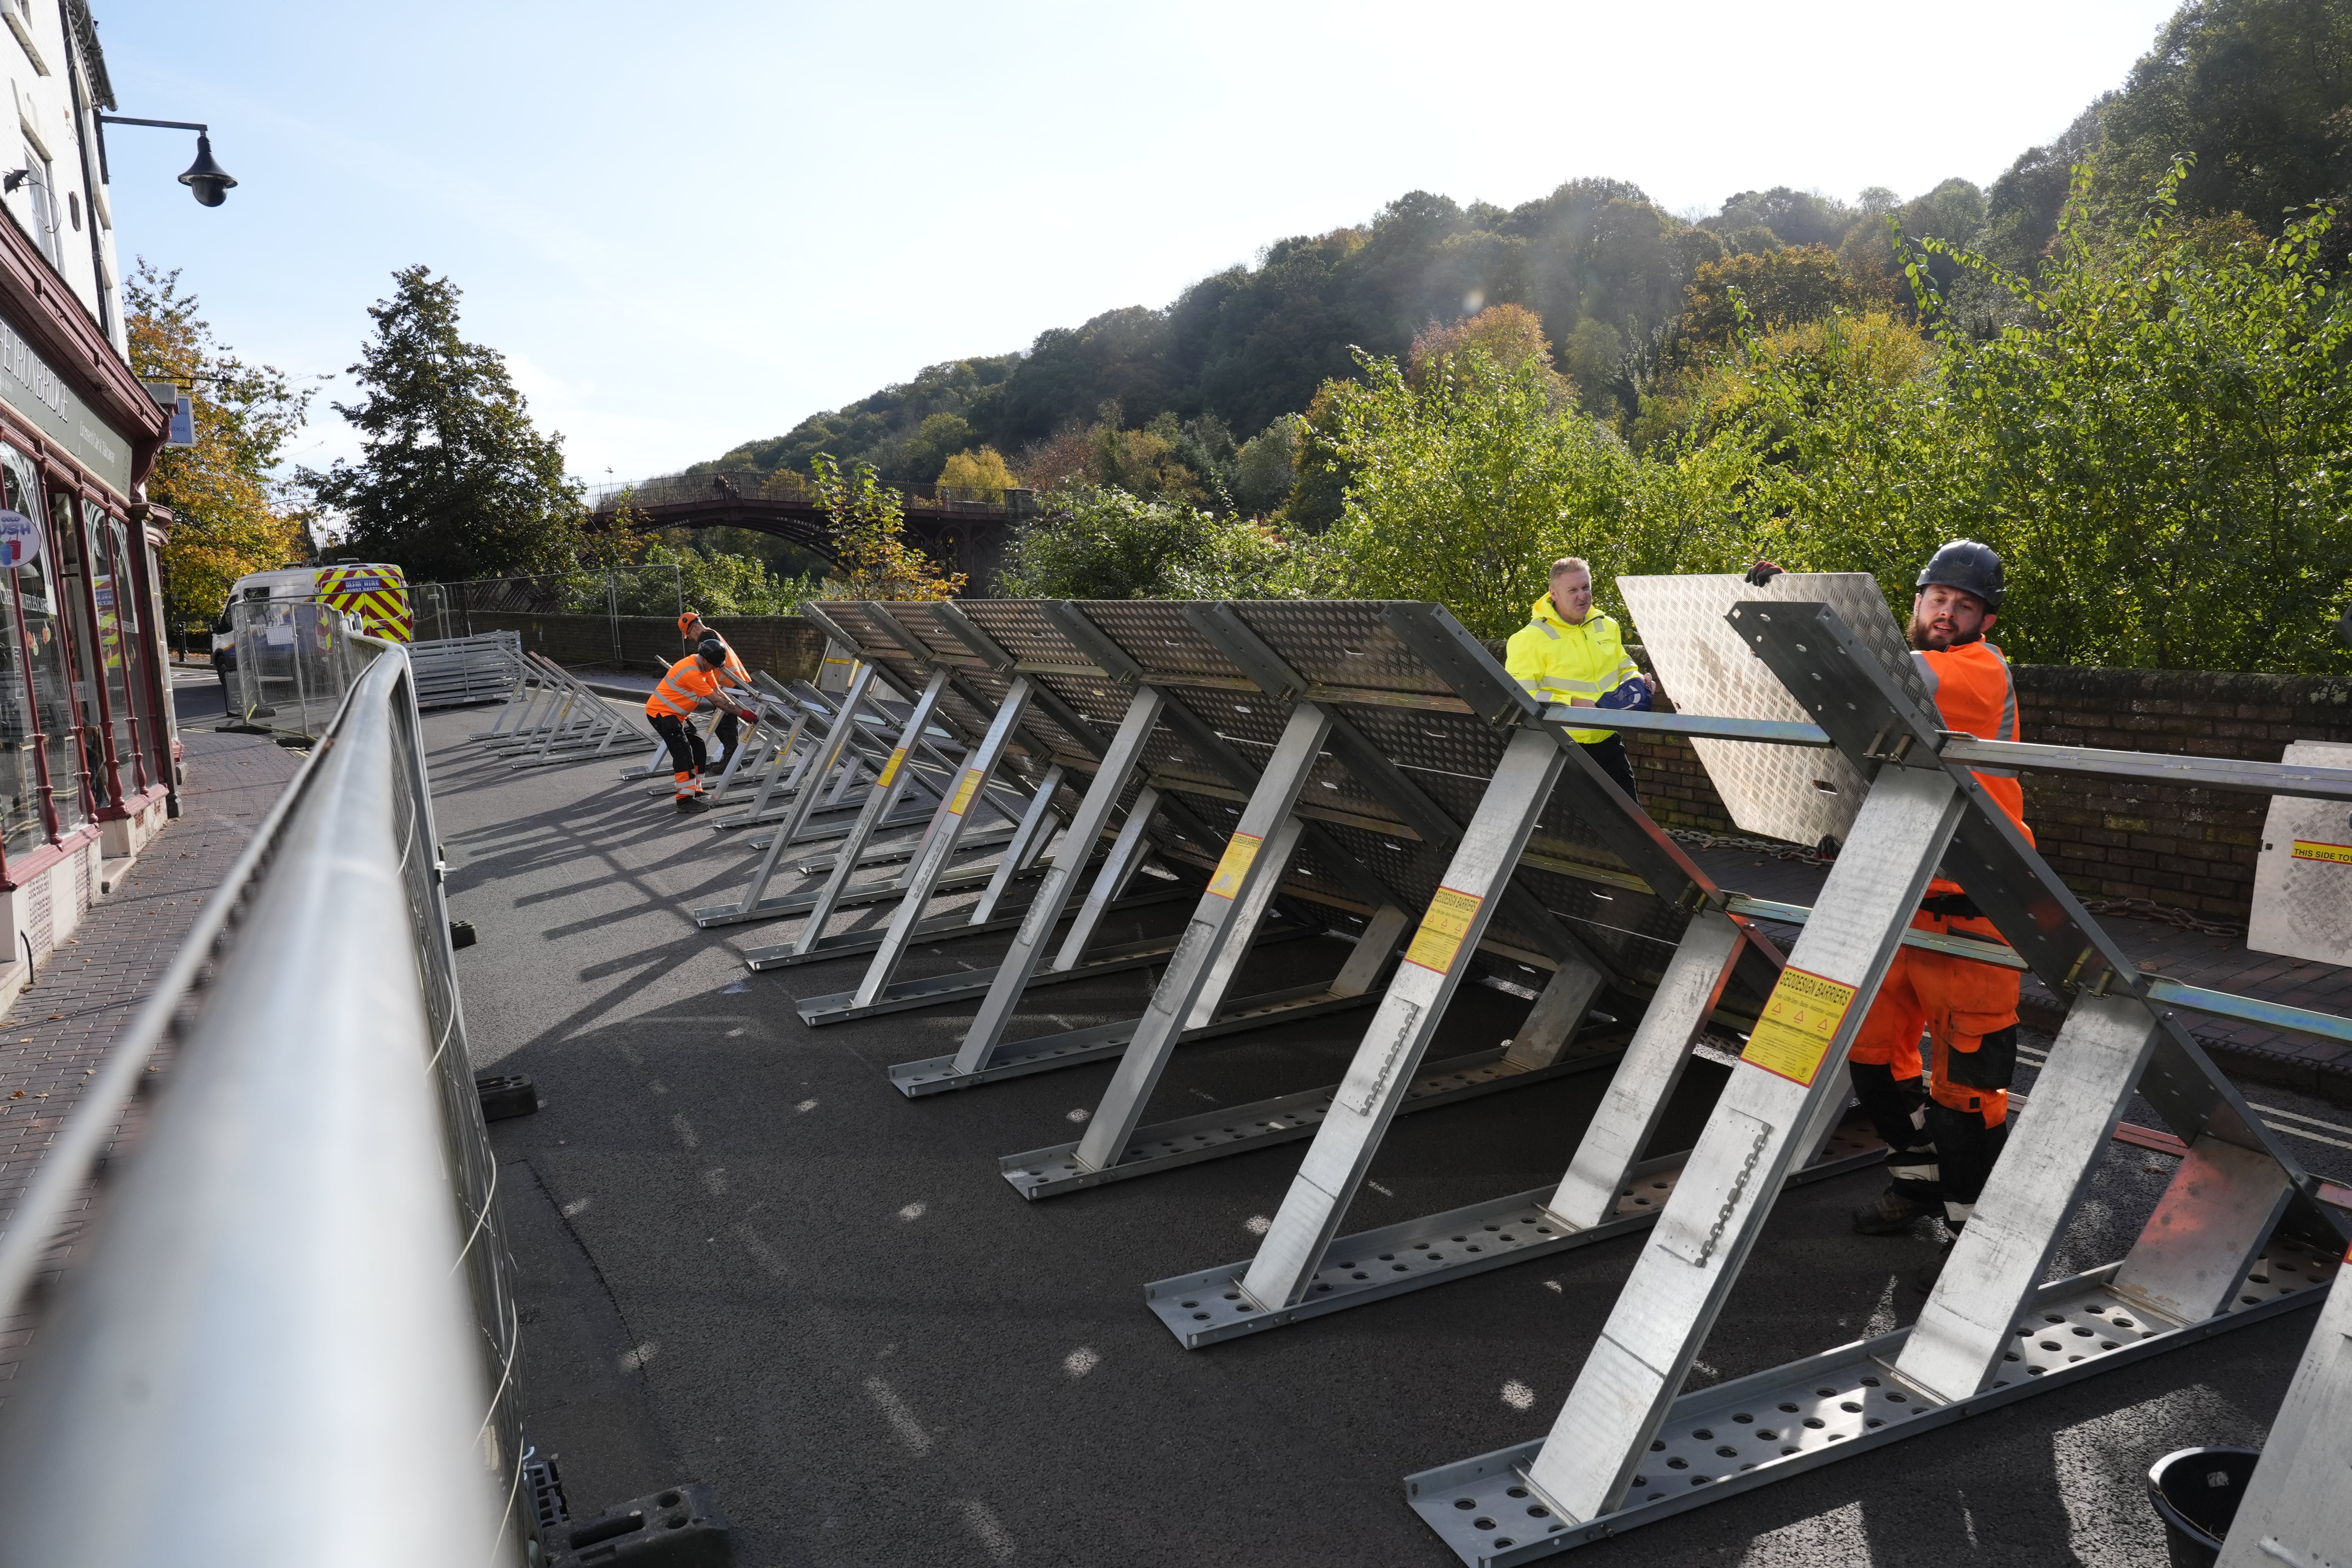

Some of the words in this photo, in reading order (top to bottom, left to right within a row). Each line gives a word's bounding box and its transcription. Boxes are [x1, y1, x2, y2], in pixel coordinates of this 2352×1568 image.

[14, 334, 69, 422] IRONBRIDGE
[2294, 848, 2313, 857] THIS
[2315, 851, 2335, 860] SIDE
[1434, 891, 1458, 907] GEODESIGN
[1455, 897, 1477, 913] BARRIERS
[1780, 971, 1818, 995] GEODESIGN
[1815, 982, 1851, 1006] BARRIERS
